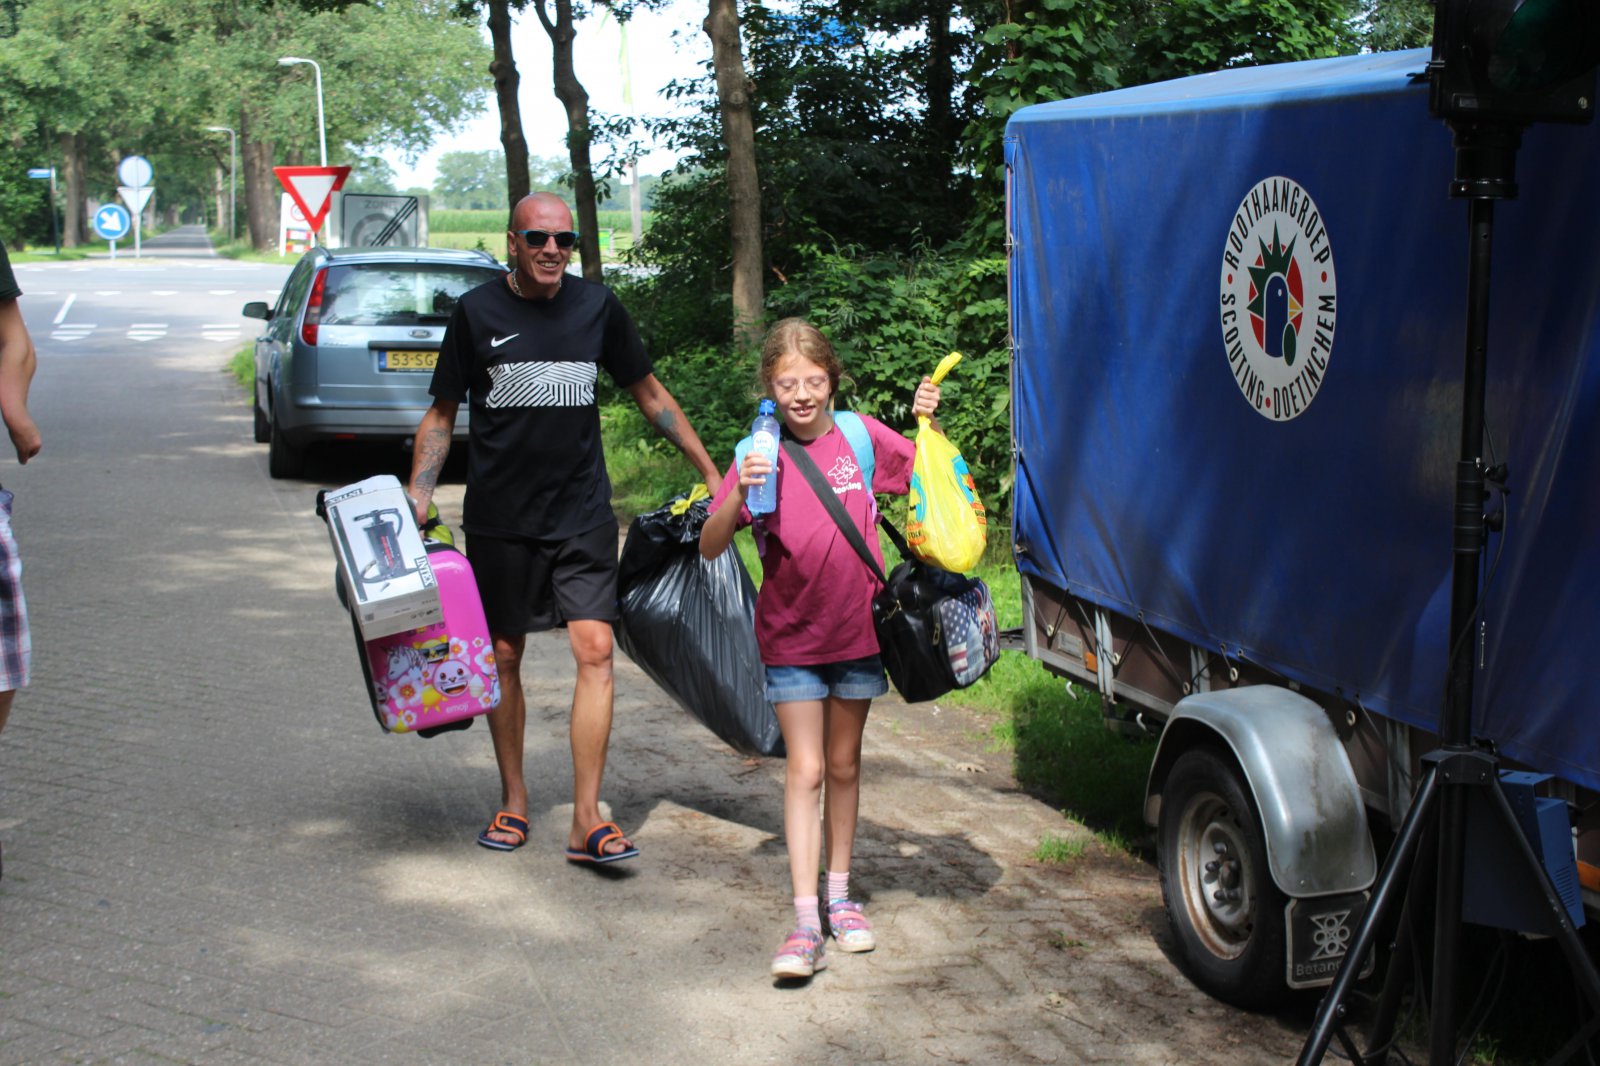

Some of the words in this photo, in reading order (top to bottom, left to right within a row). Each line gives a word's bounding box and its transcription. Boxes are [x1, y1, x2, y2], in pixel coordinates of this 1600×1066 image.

[1224, 179, 1330, 270] ROOTHAANGROEP
[1222, 293, 1264, 410] SCOUTING
[1273, 295, 1335, 418] DOETINCHEM
[415, 556, 434, 587] INTEX
[446, 702, 469, 714] emoji
